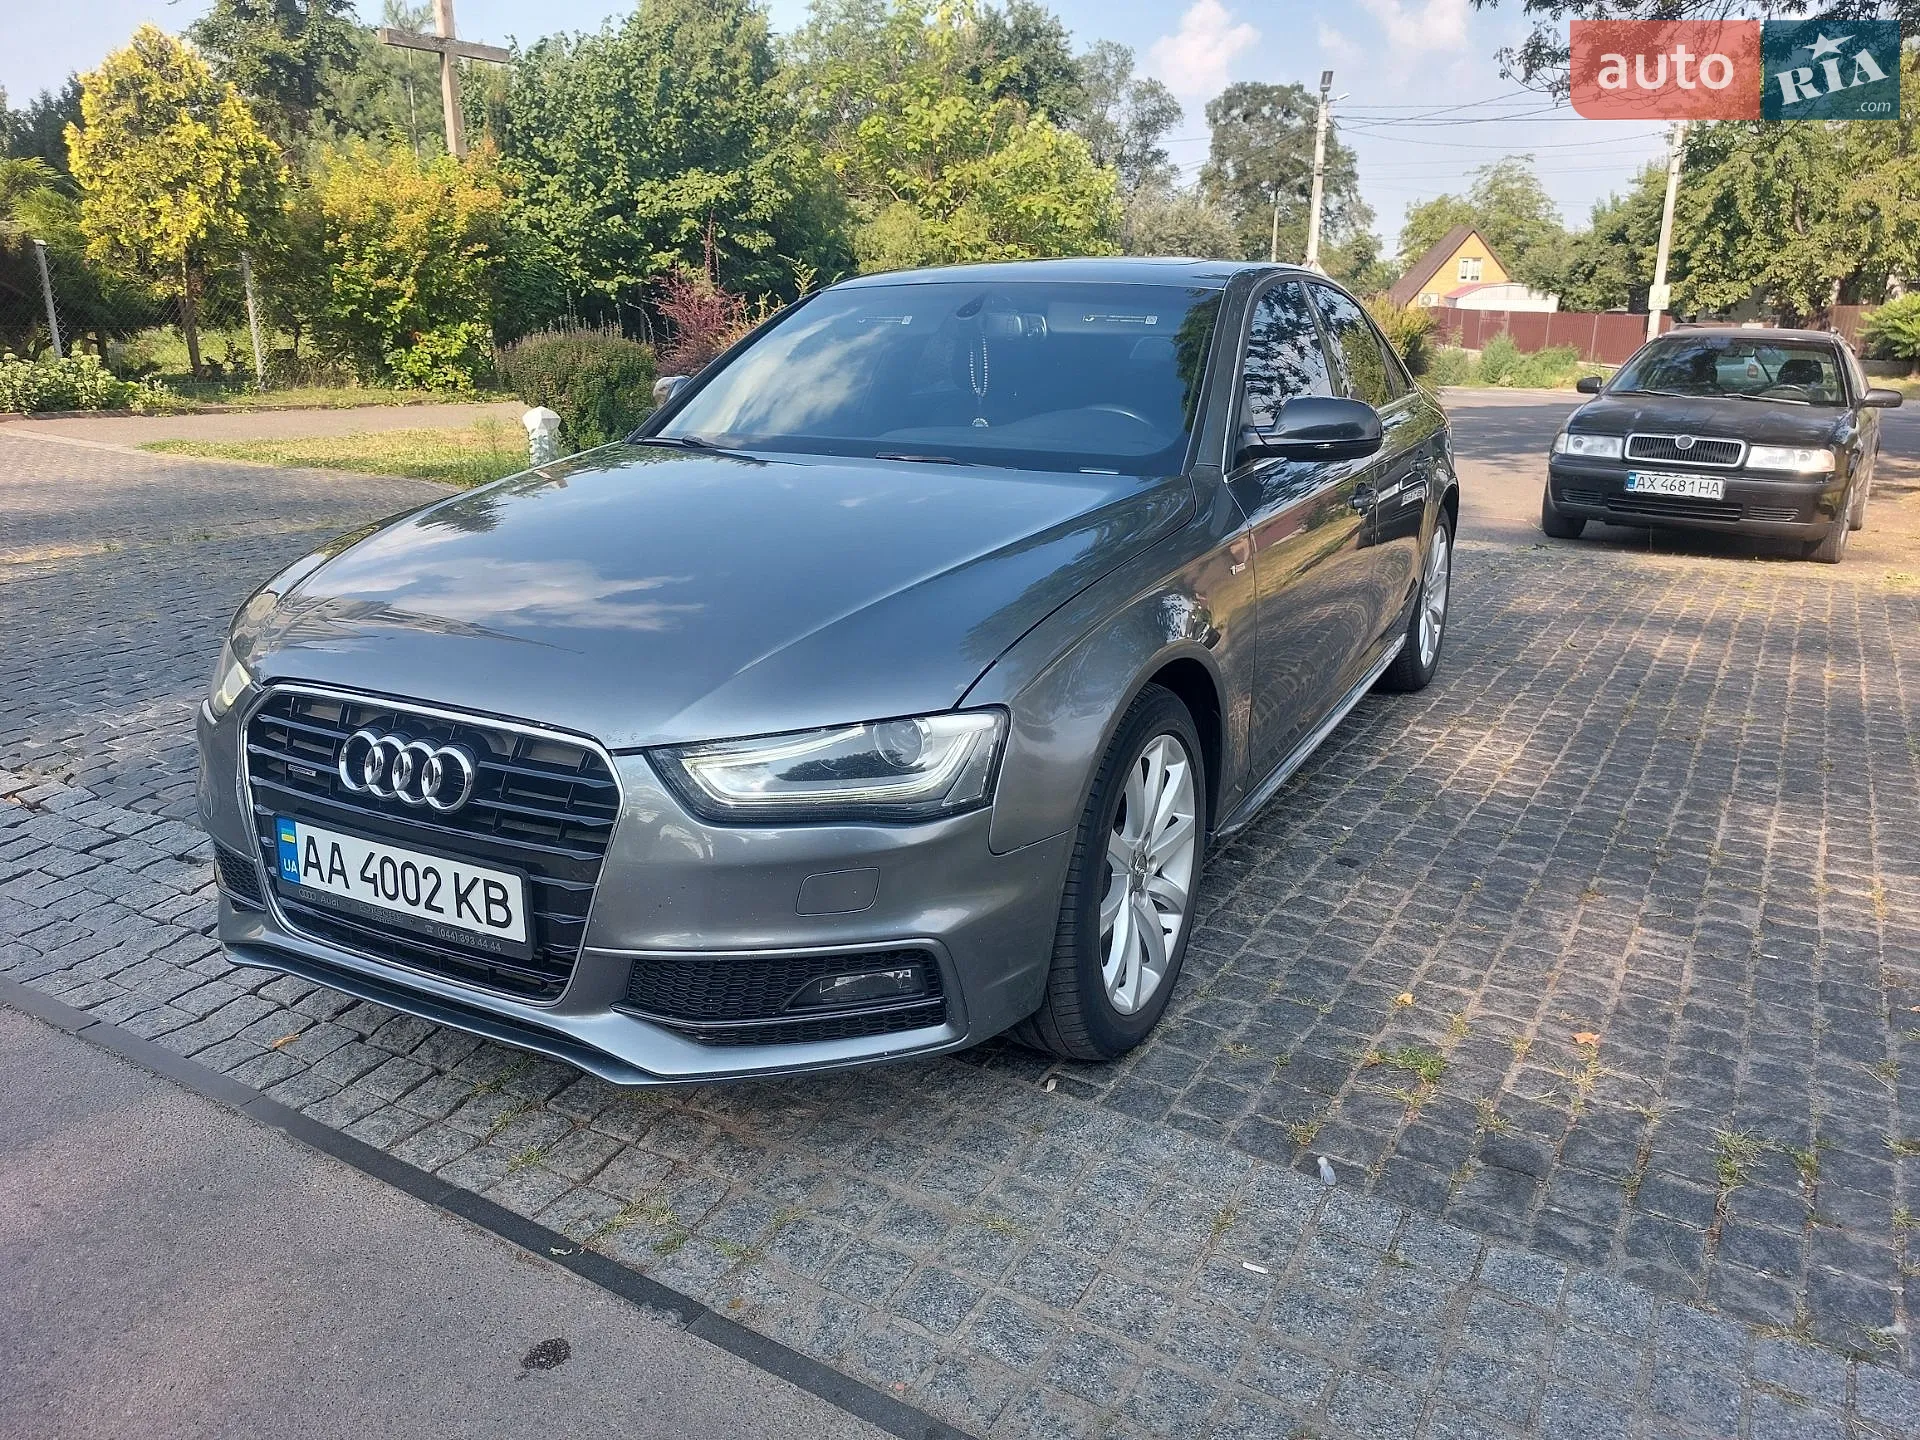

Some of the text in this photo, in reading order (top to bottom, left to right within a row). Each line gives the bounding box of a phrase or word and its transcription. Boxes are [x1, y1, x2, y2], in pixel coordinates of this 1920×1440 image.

[1636, 476, 1656, 490] AX
[1660, 479, 1695, 493] 4681
[1698, 481, 1720, 495] HA
[283, 857, 298, 874] UA
[303, 835, 512, 929] AA 4002 KB
[320, 896, 340, 907] Audi
[437, 926, 502, 952] (044) 393 44 44
